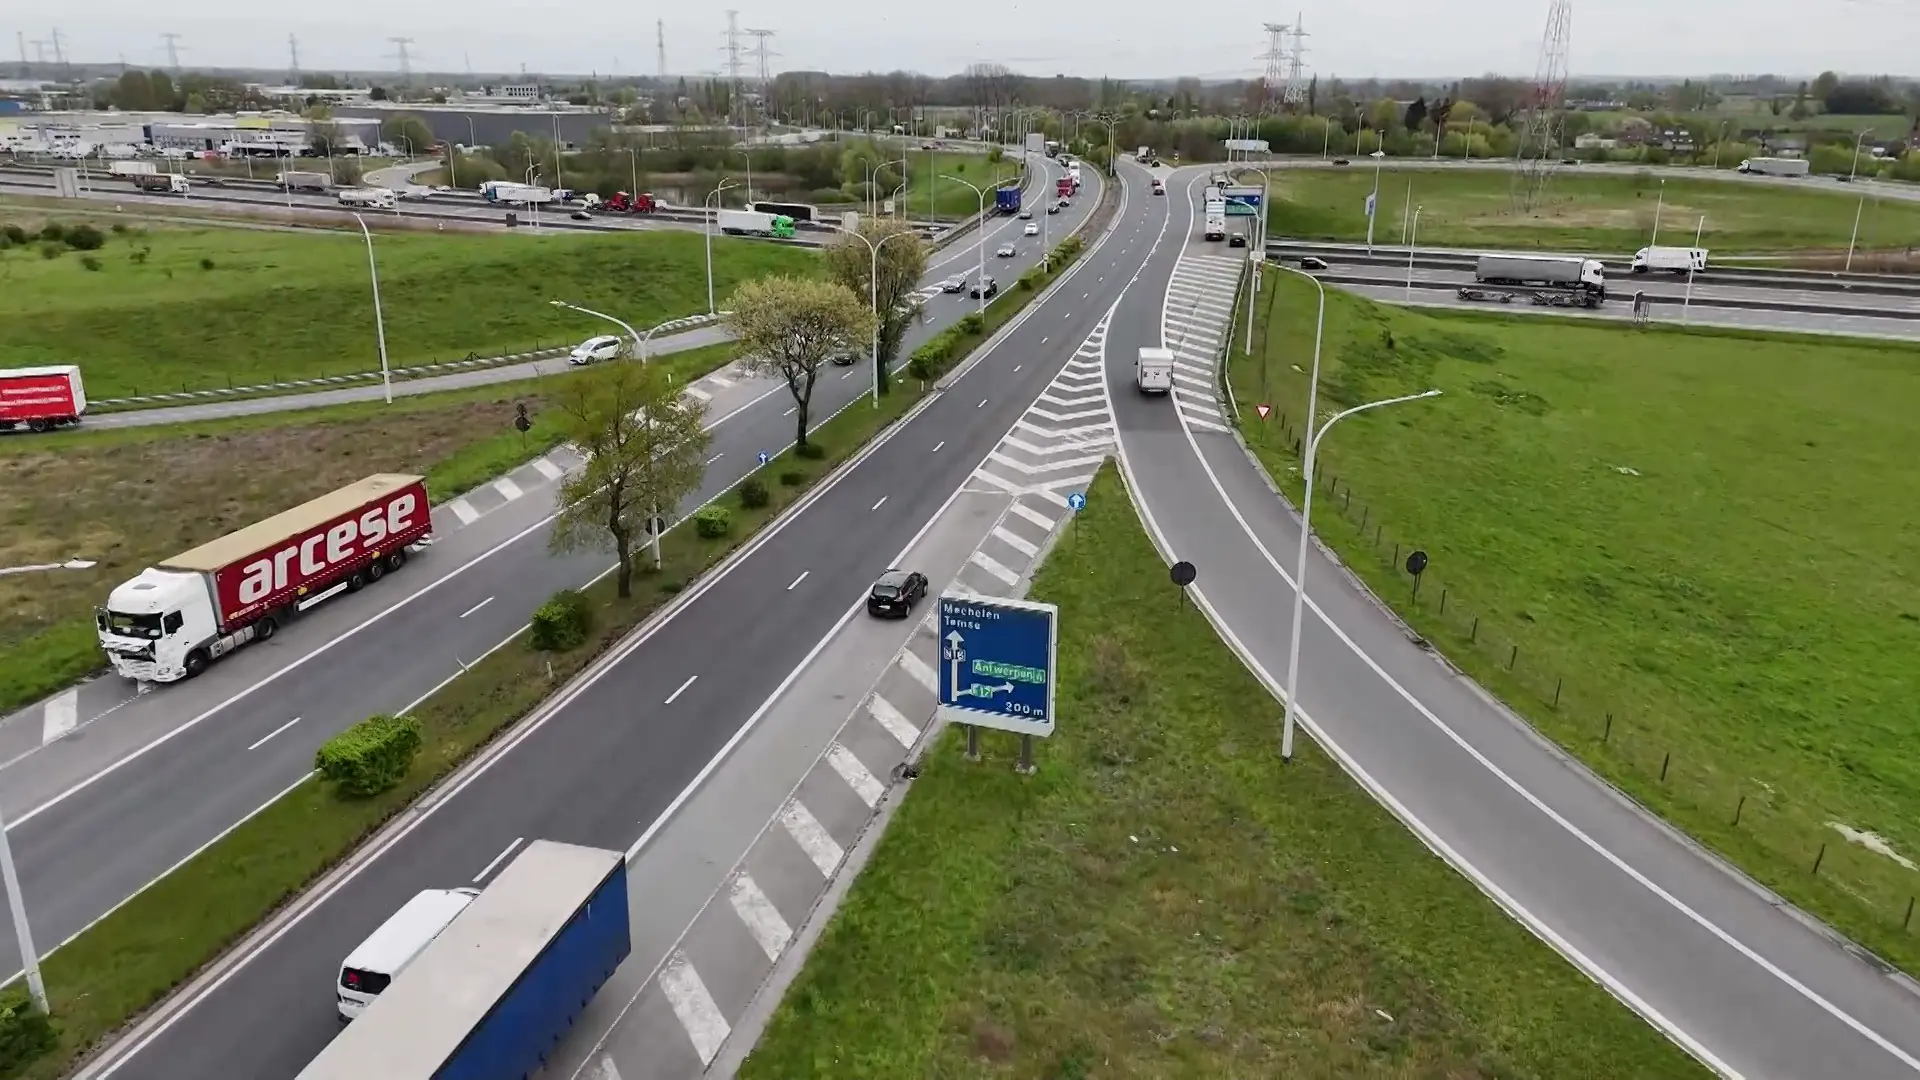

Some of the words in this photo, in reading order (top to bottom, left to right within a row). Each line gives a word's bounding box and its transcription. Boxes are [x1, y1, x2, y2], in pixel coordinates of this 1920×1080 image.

[239, 493, 416, 604] arcese
[944, 603, 1000, 620] Mechelen
[944, 615, 981, 630] Temse
[974, 661, 1033, 679] Antwerpen
[1005, 701, 1030, 714] 200
[1033, 708, 1044, 716] m
